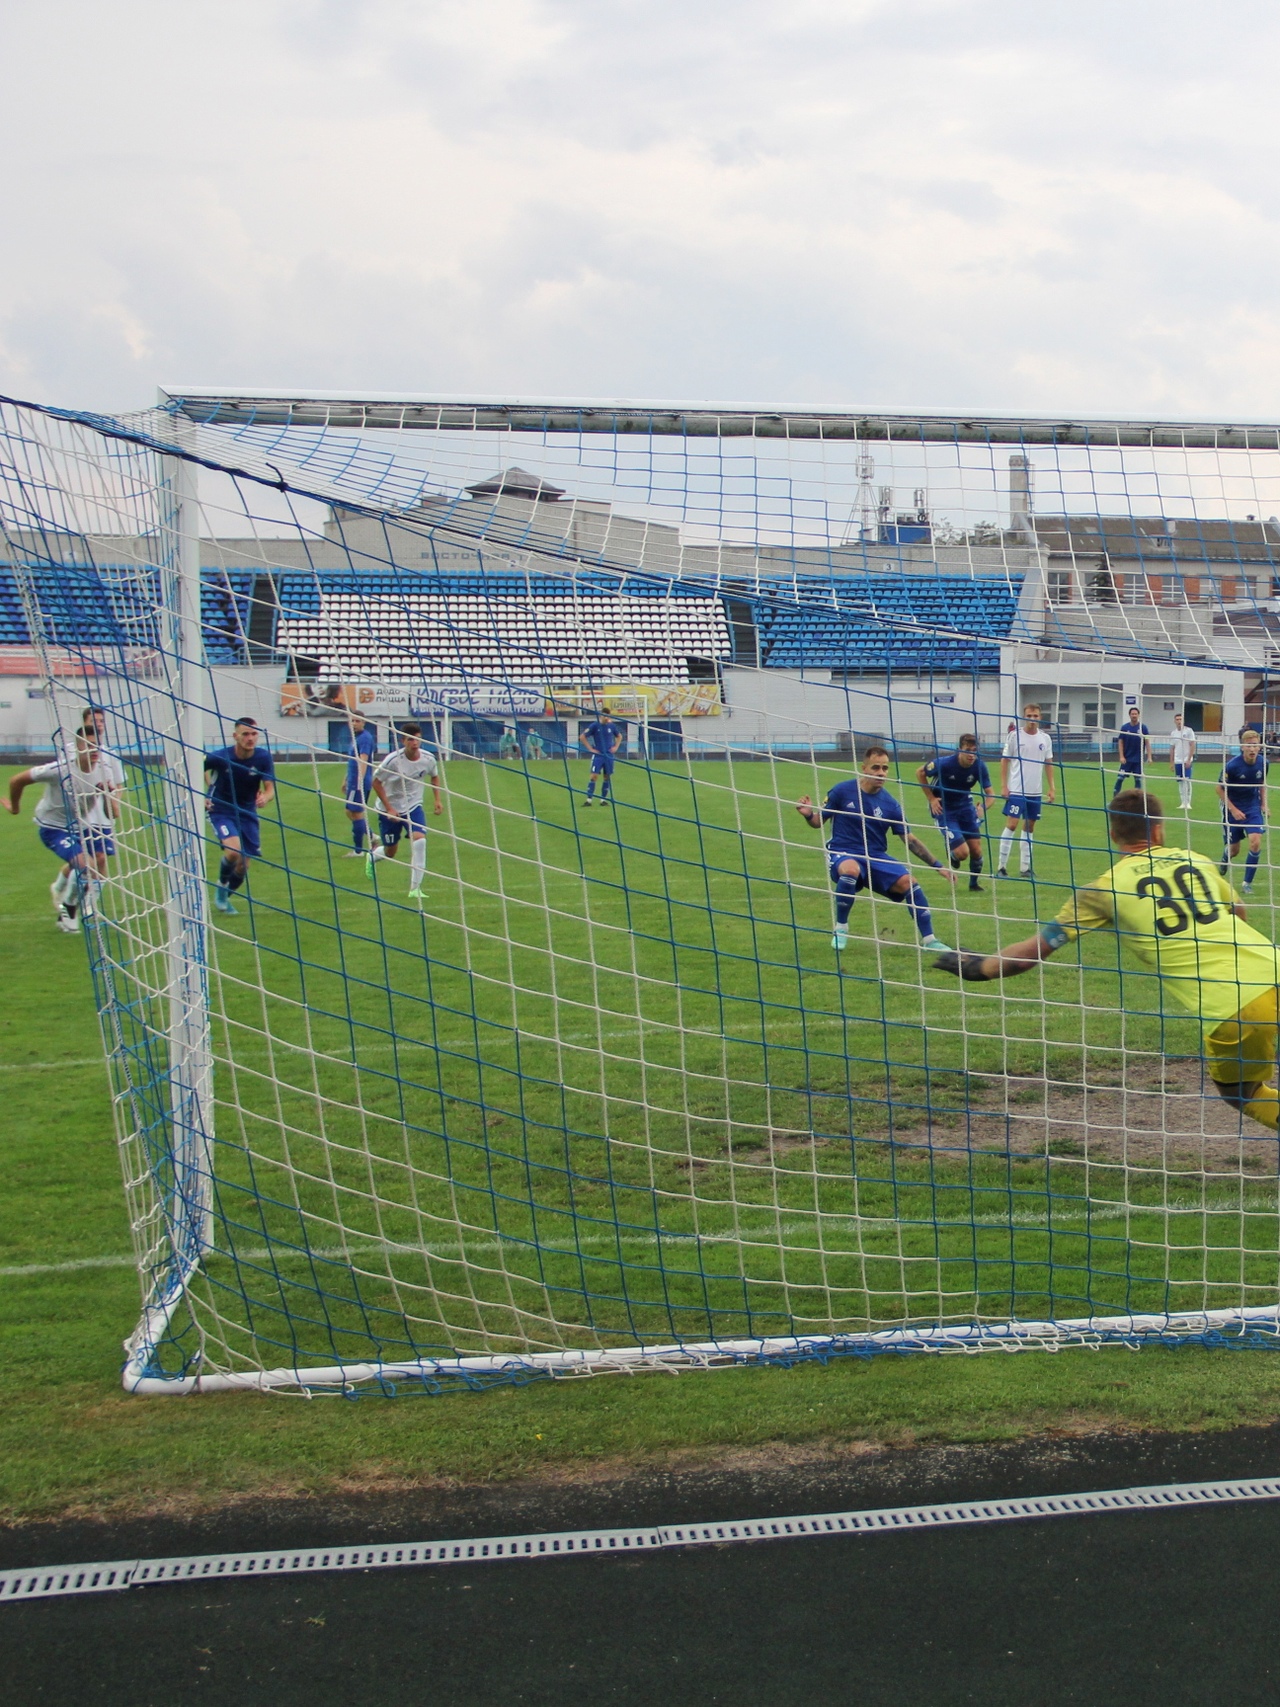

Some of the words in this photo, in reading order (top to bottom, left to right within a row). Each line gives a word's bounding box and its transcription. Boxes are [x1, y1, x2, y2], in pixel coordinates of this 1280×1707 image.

[417, 688, 480, 705] КЛЕВОЕ
[1009, 805, 1020, 815] 39
[1137, 865, 1219, 936] 30
